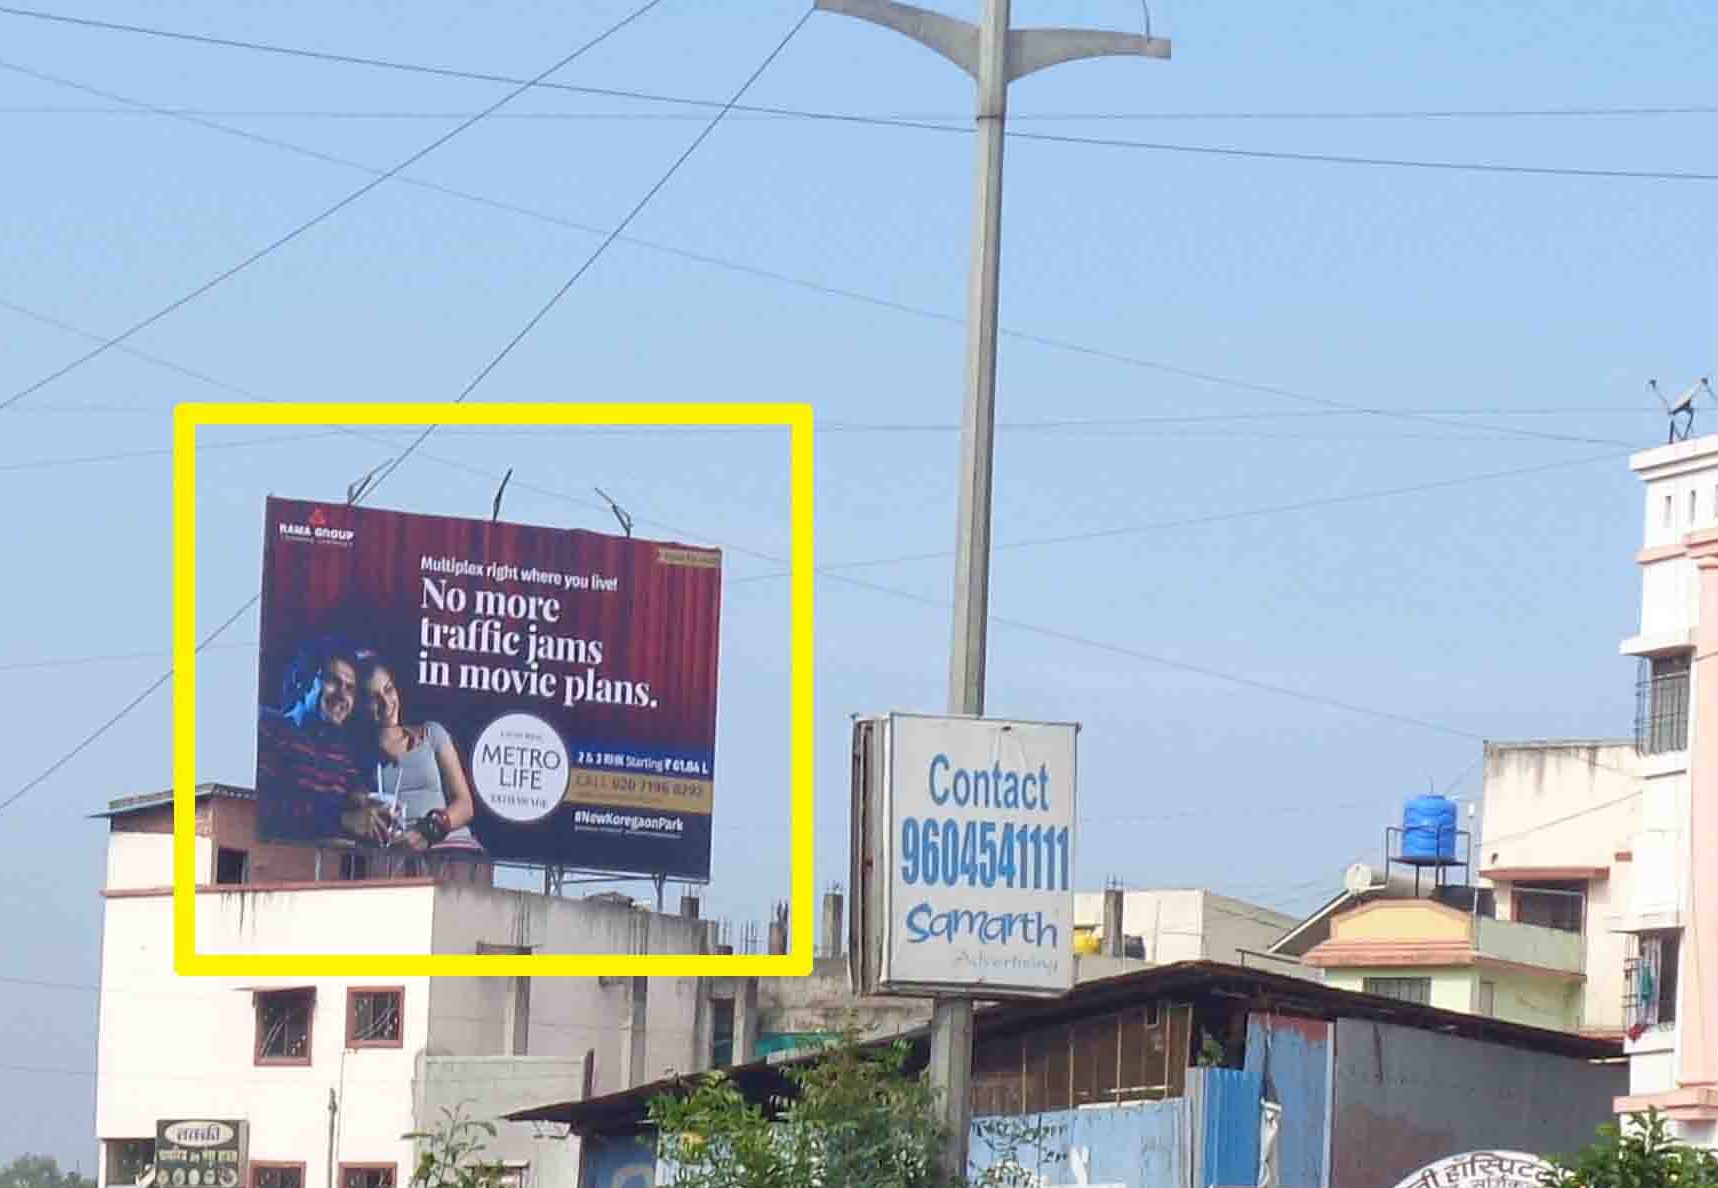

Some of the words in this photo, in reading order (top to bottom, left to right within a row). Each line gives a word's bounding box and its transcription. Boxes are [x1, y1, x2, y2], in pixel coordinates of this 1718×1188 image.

[314, 528, 355, 541] GROUP
[420, 557, 483, 577] Multiplex
[487, 562, 518, 581] right
[521, 569, 561, 585] where
[564, 576, 588, 590] you
[421, 577, 466, 611] No
[474, 589, 560, 622] more
[421, 617, 519, 656] traffic
[526, 625, 603, 664] jams
[418, 651, 450, 687] in
[459, 663, 557, 697] movie
[563, 668, 658, 708] plans.
[482, 744, 561, 769] METRO
[626, 755, 663, 772] Starting
[499, 767, 542, 790] LIFE
[929, 753, 1050, 812] Contact
[575, 810, 683, 833] #NewKoregaonPark
[902, 817, 1070, 891] 9604541111
[907, 902, 1058, 948] Samarth
